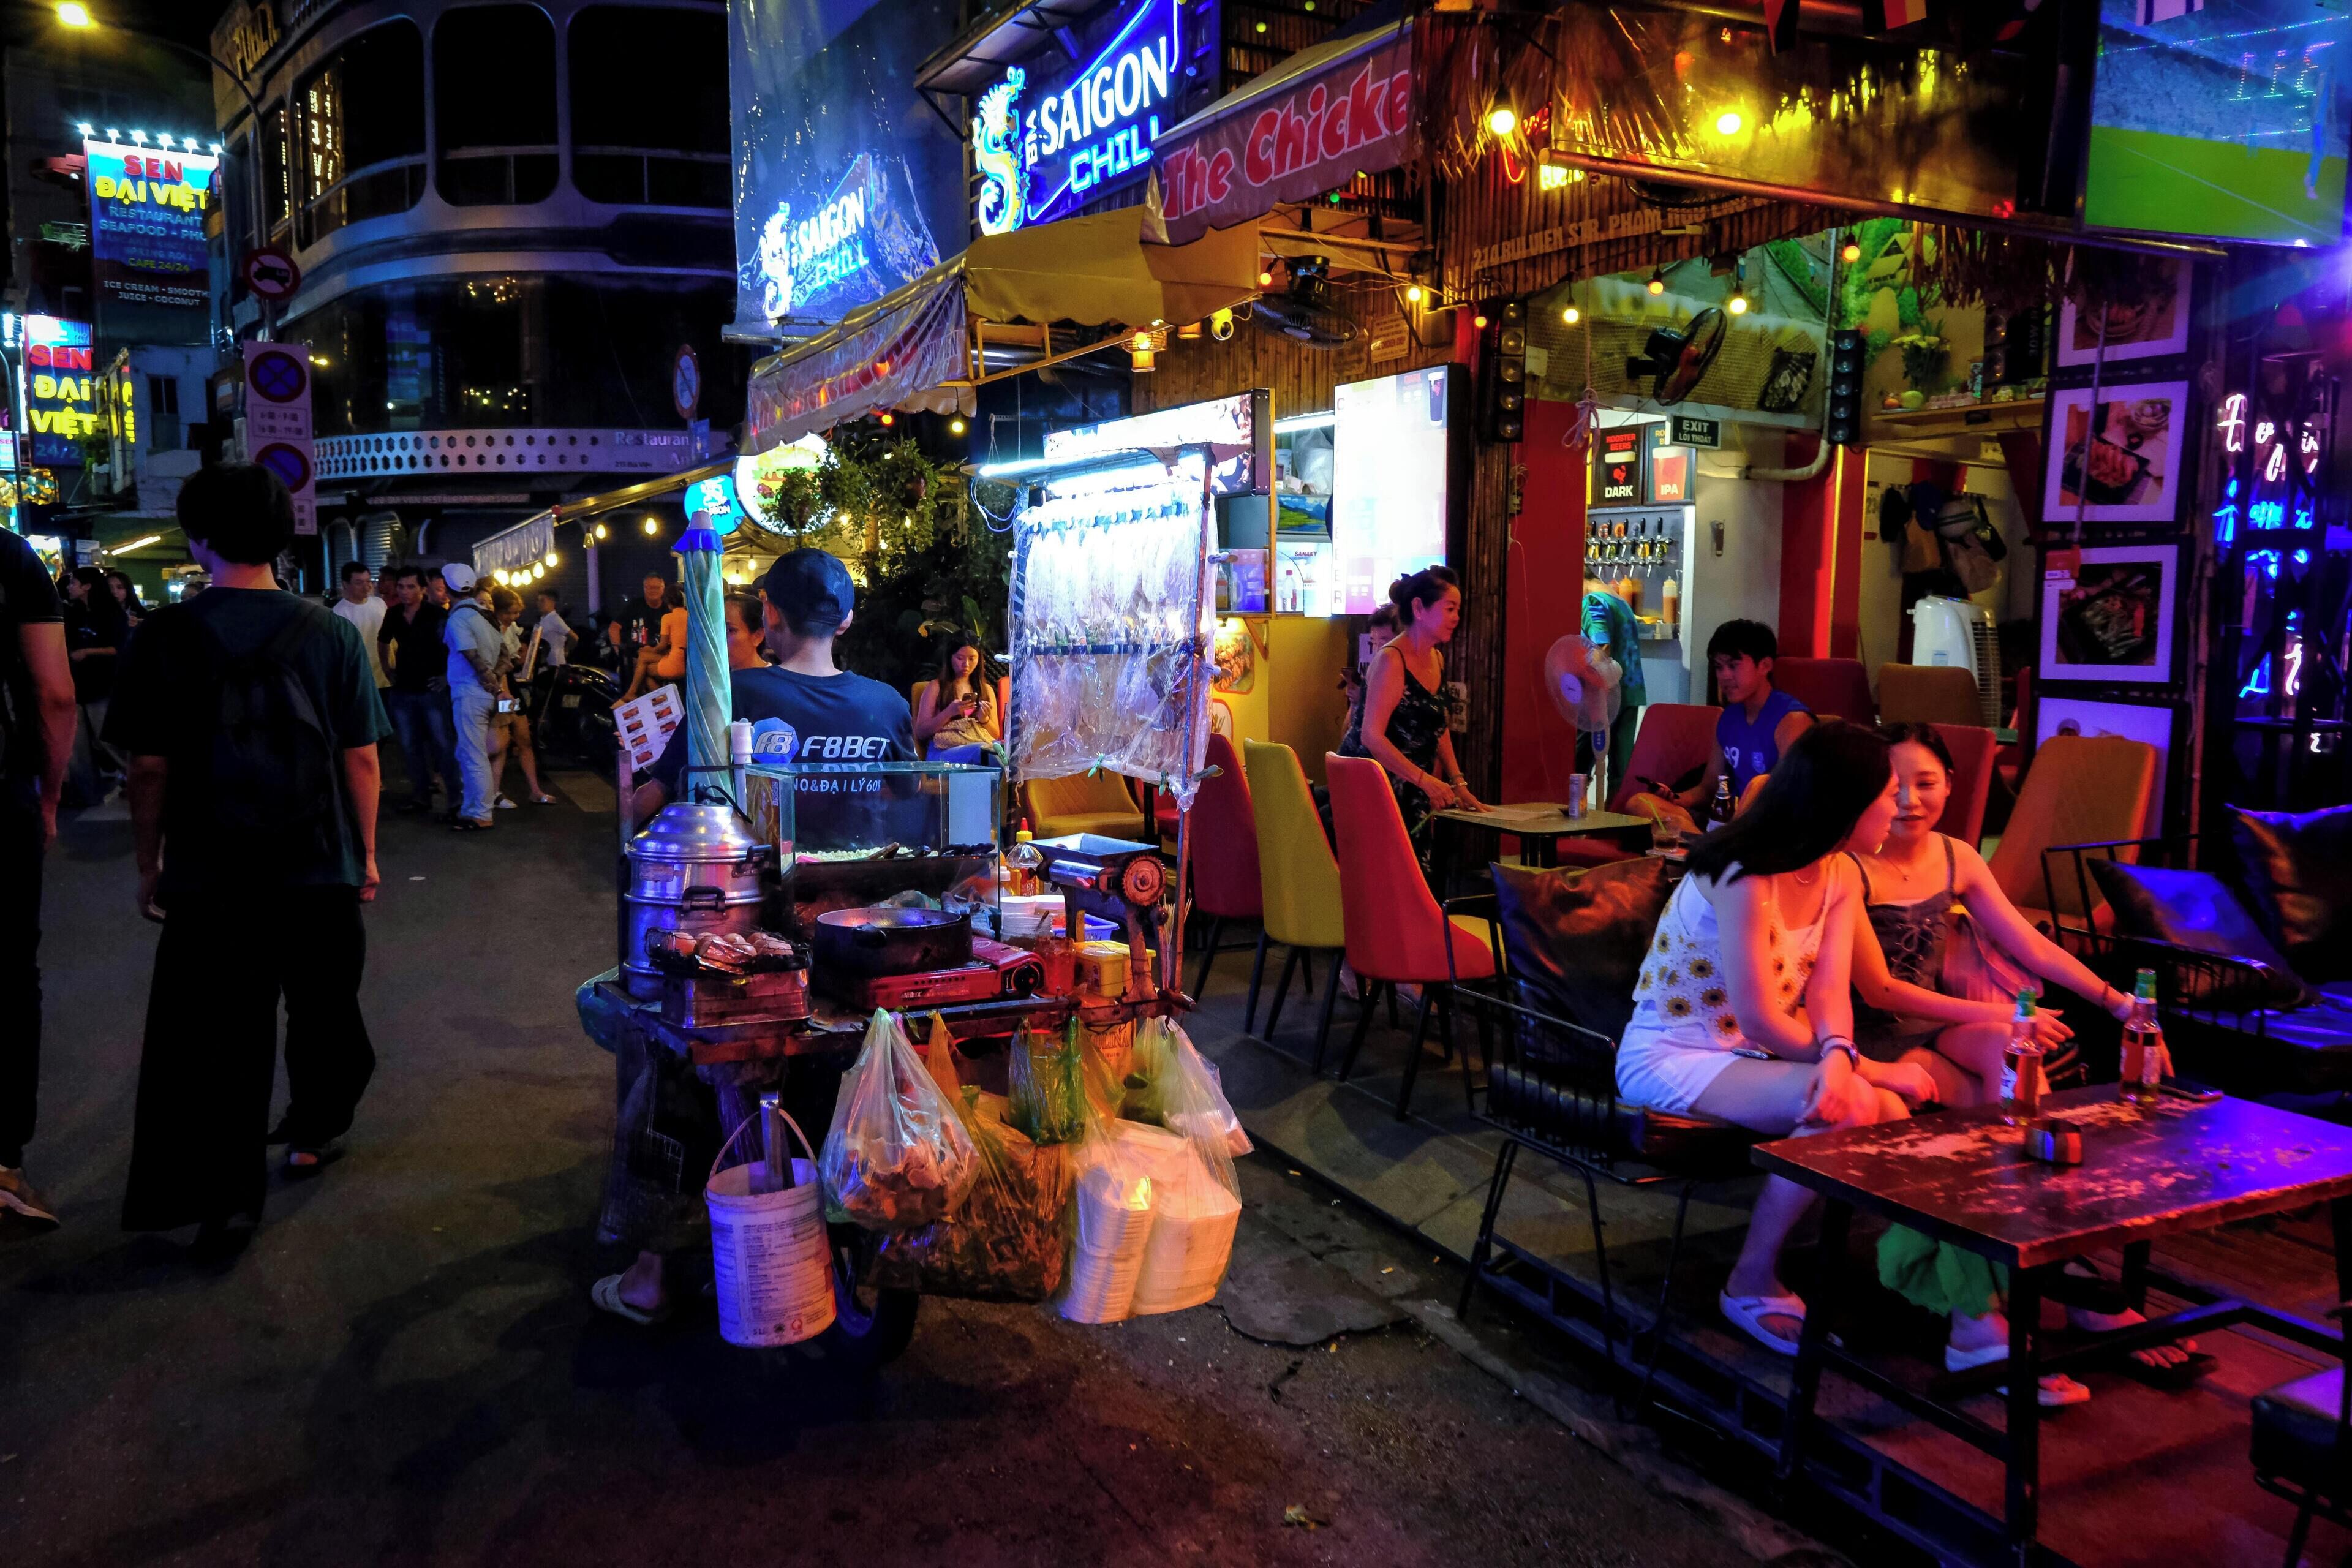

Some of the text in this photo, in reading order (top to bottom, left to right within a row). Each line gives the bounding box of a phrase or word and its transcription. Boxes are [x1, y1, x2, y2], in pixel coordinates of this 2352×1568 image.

[1041, 36, 1167, 156] SAIGON
[124, 154, 183, 182] SEN
[1161, 137, 1234, 222] The
[95, 176, 206, 213] ĐẠI VIỆT
[108, 206, 203, 227] RESTAURANT
[99, 219, 167, 237] SEAFOOD
[128, 257, 190, 272] CAFE 24/24
[104, 280, 122, 288] ICE
[124, 282, 159, 293] CREAM
[118, 292, 147, 301] JUICE
[154, 295, 200, 306] COCONUT
[30, 344, 92, 371] SEN
[29, 406, 98, 440] VIỆT
[1682, 420, 1709, 433] EXIT
[614, 431, 690, 445] Restauran
[1605, 433, 1636, 443] ROOSTER
[1610, 442, 1632, 451] BEERS
[35, 442, 80, 459] 24/2
[1605, 485, 1634, 498] DARK
[1660, 484, 1679, 495] IPA
[753, 731, 891, 760] F8 F8BET
